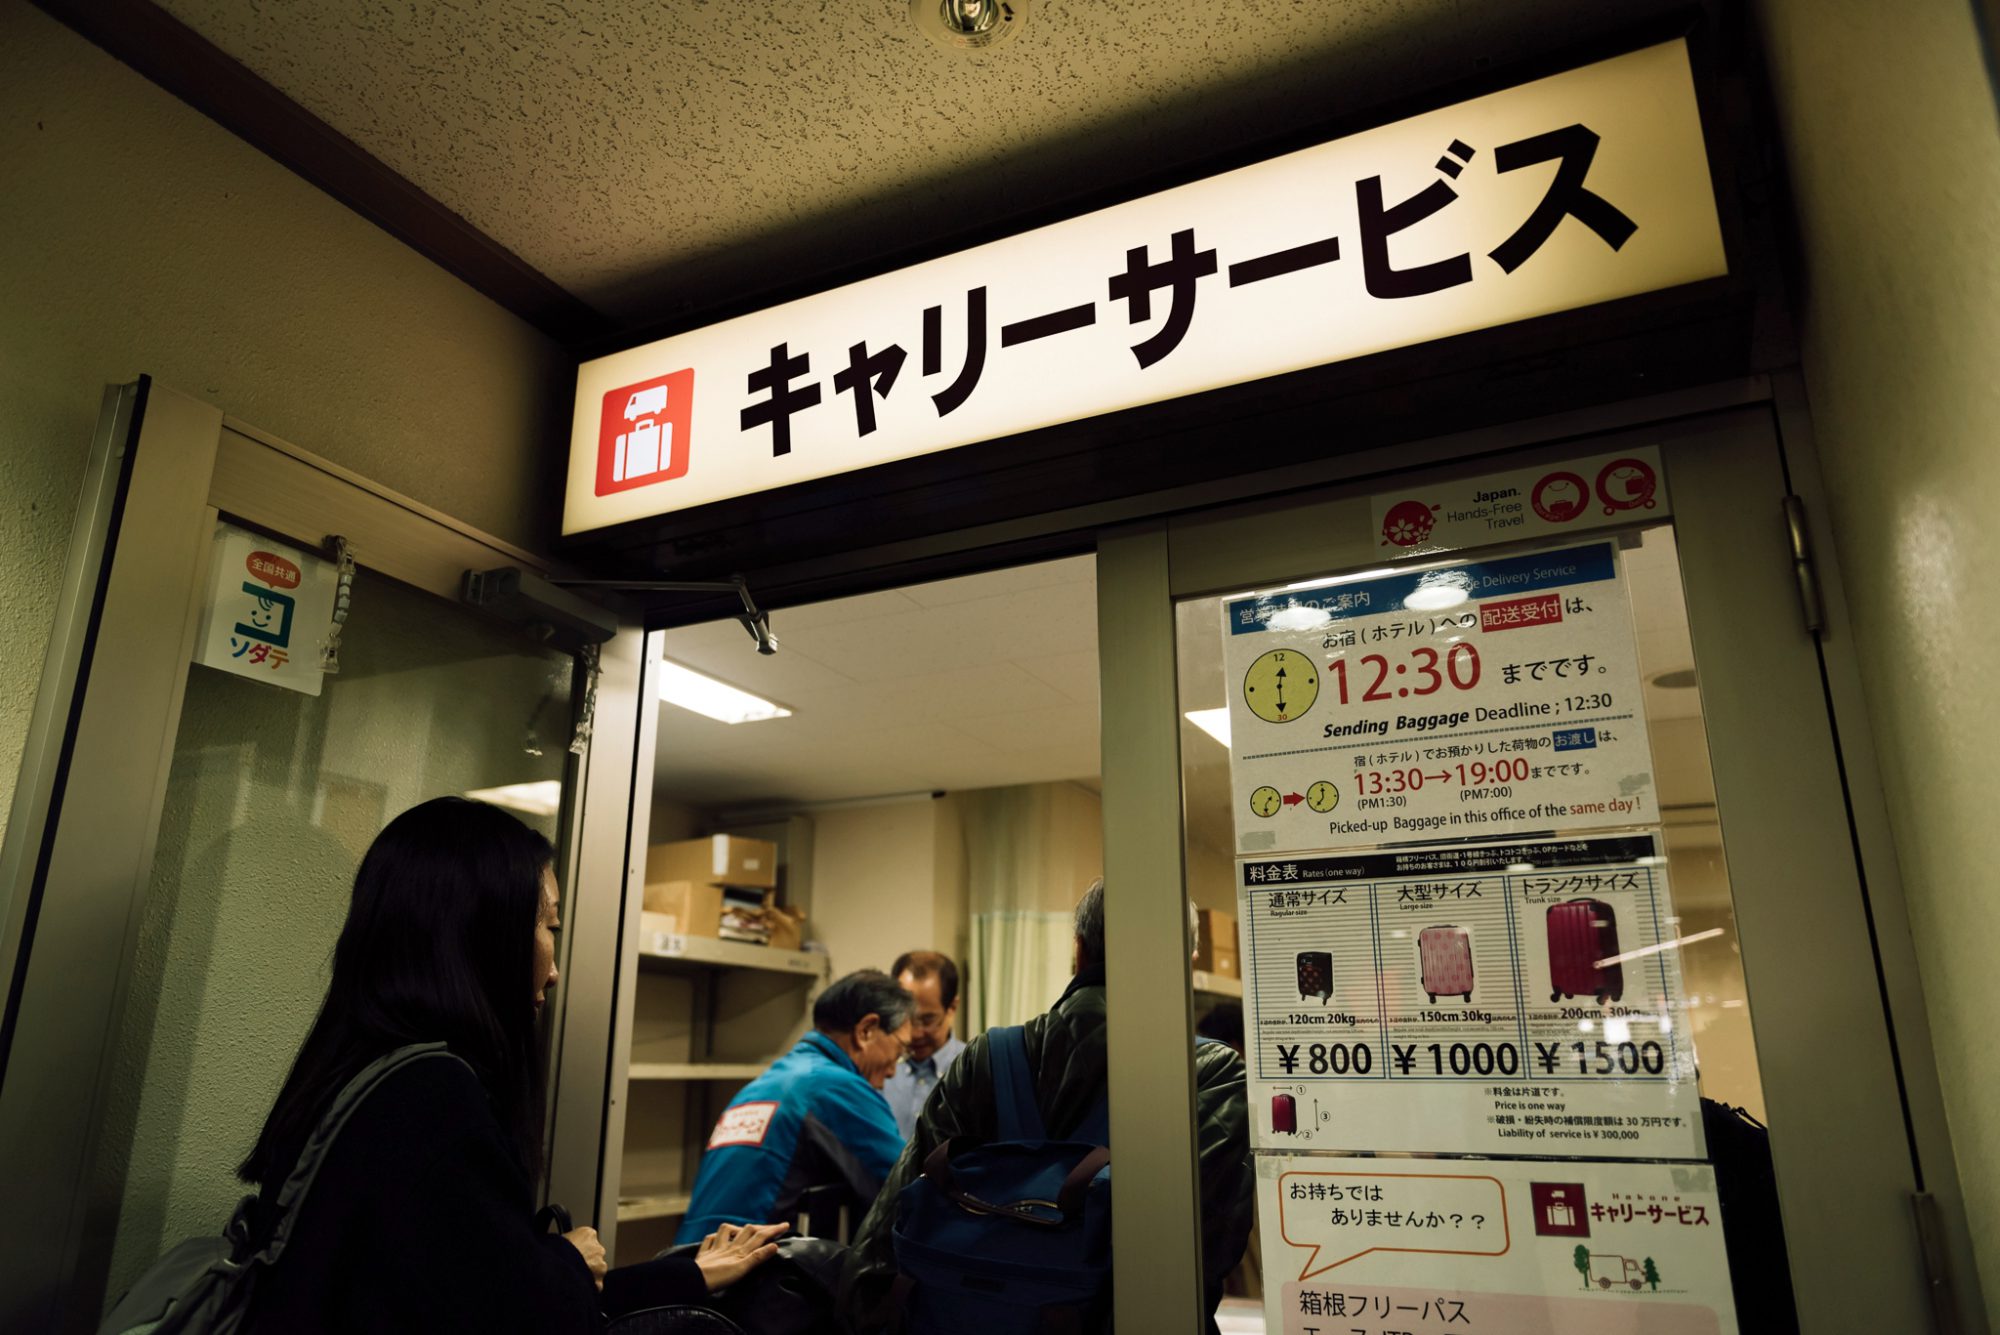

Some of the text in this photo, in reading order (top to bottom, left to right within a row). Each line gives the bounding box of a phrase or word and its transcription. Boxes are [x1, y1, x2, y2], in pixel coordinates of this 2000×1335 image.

[739, 122, 1639, 458] キャリーサービス
[1472, 488, 1521, 503] Japan.
[1447, 501, 1523, 523] Hands-Free
[1487, 514, 1524, 530] Travel
[252, 557, 297, 583] 全国共通
[1483, 572, 1530, 588] Delivery
[1534, 563, 1577, 579] Service
[1482, 601, 1560, 628] 配送受付
[230, 637, 290, 670] ソダテ
[1274, 653, 1285, 662] 12
[1328, 642, 1607, 706] 12:30 までです。
[1323, 719, 1388, 739] Sending
[1395, 709, 1469, 732] Baggage
[1475, 702, 1550, 722] Deadline
[1564, 693, 1612, 712] 12:30
[1554, 732, 1595, 747] お渡し
[1354, 758, 1590, 795] 13:30 19:00 までです。
[1357, 796, 1407, 811] (PM1:30)
[1460, 786, 1512, 801] (PM7:00)
[1330, 819, 1388, 836] Picked-up
[1393, 814, 1447, 831] Baggage
[1450, 813, 1461, 825] in
[1463, 810, 1487, 823] this
[1490, 807, 1526, 822] office
[1529, 806, 1541, 819] of
[1545, 804, 1567, 817] the
[1570, 803, 1605, 815] same
[1608, 798, 1633, 814] day
[1250, 864, 1299, 882] 料金表
[1303, 869, 1324, 879] Rates
[1397, 877, 1482, 902] 大型サイズ
[1523, 872, 1639, 895] トランクサイズ
[1268, 887, 1348, 908] 通常サイズ
[1400, 903, 1419, 911] Large
[1525, 896, 1546, 904] Trunk
[1289, 1013, 1325, 1024] 120cm
[1327, 1013, 1356, 1027] 20kg
[1420, 1011, 1458, 1023] 150cm
[1461, 1010, 1491, 1024] 30kg
[1484, 1087, 1565, 1098] ※料金は片道です。
[1495, 1101, 1517, 1110] Price
[1518, 1101, 1526, 1110] is
[1547, 1103, 1565, 1112] way
[1498, 1129, 1534, 1140] Liability
[1536, 1129, 1545, 1138] of
[1550, 1130, 1581, 1139] service
[1583, 1130, 1591, 1139] is
[1290, 1182, 1384, 1201] お持ちでは
[1591, 1202, 1710, 1226] キャリーサービス
[1299, 1289, 1471, 1324] 箱根フリーパス
